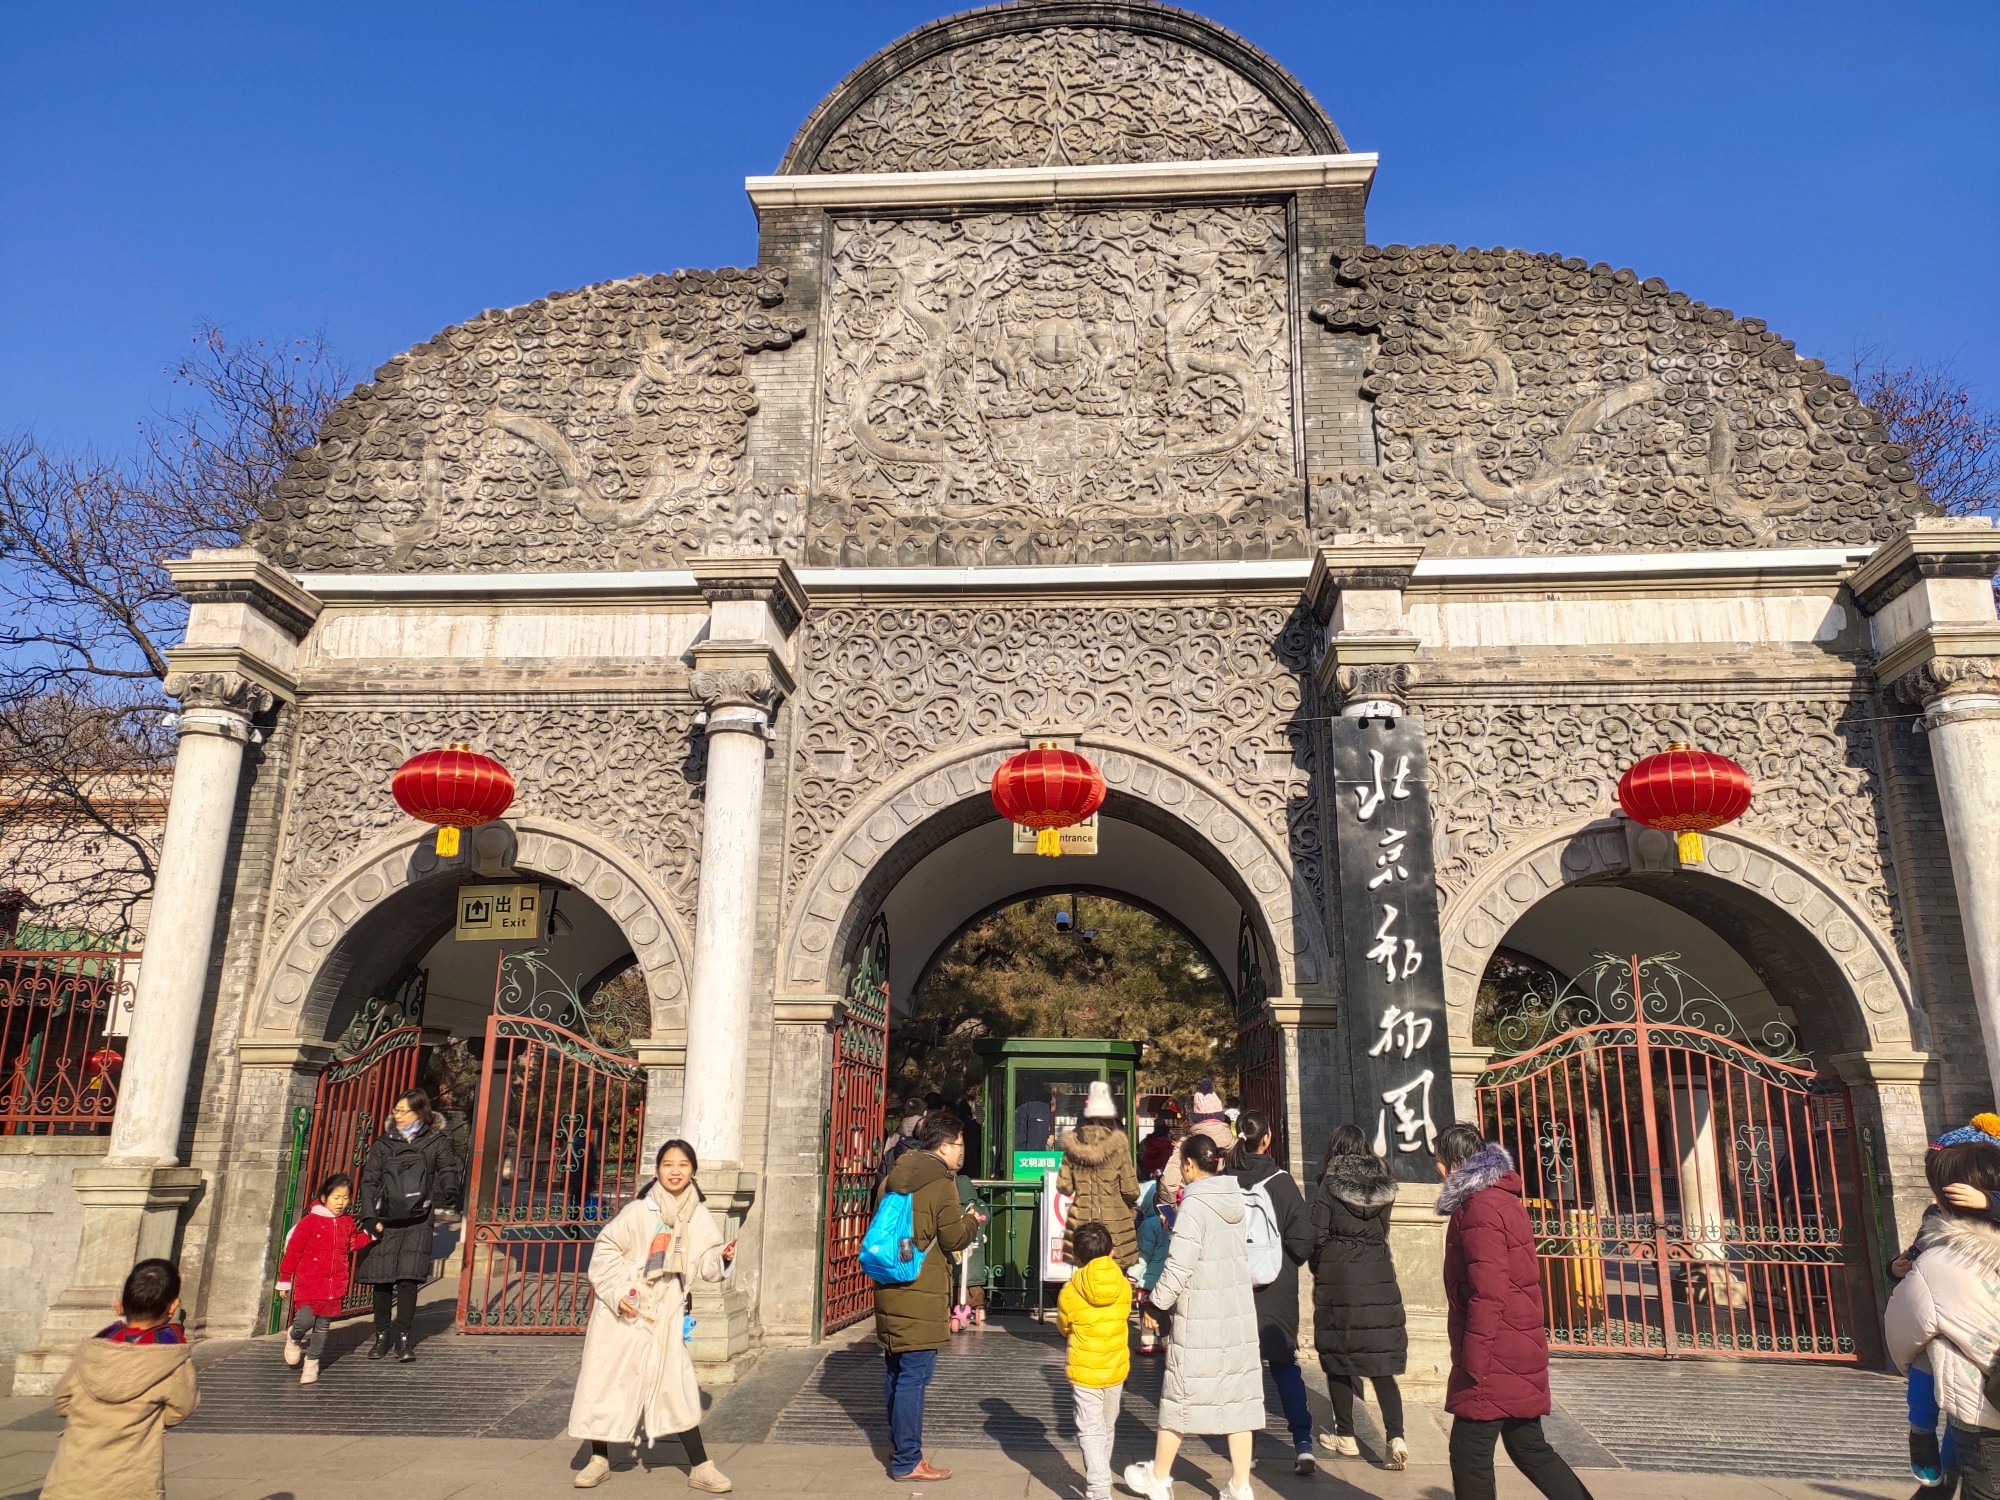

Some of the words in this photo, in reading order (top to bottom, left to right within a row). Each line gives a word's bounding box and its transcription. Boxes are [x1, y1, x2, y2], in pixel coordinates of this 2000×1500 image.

[1060, 834, 1093, 843] ntrance
[496, 896, 535, 913] 出口
[502, 918, 526, 928] Exit
[1019, 1157, 1056, 1168] 文明游园
